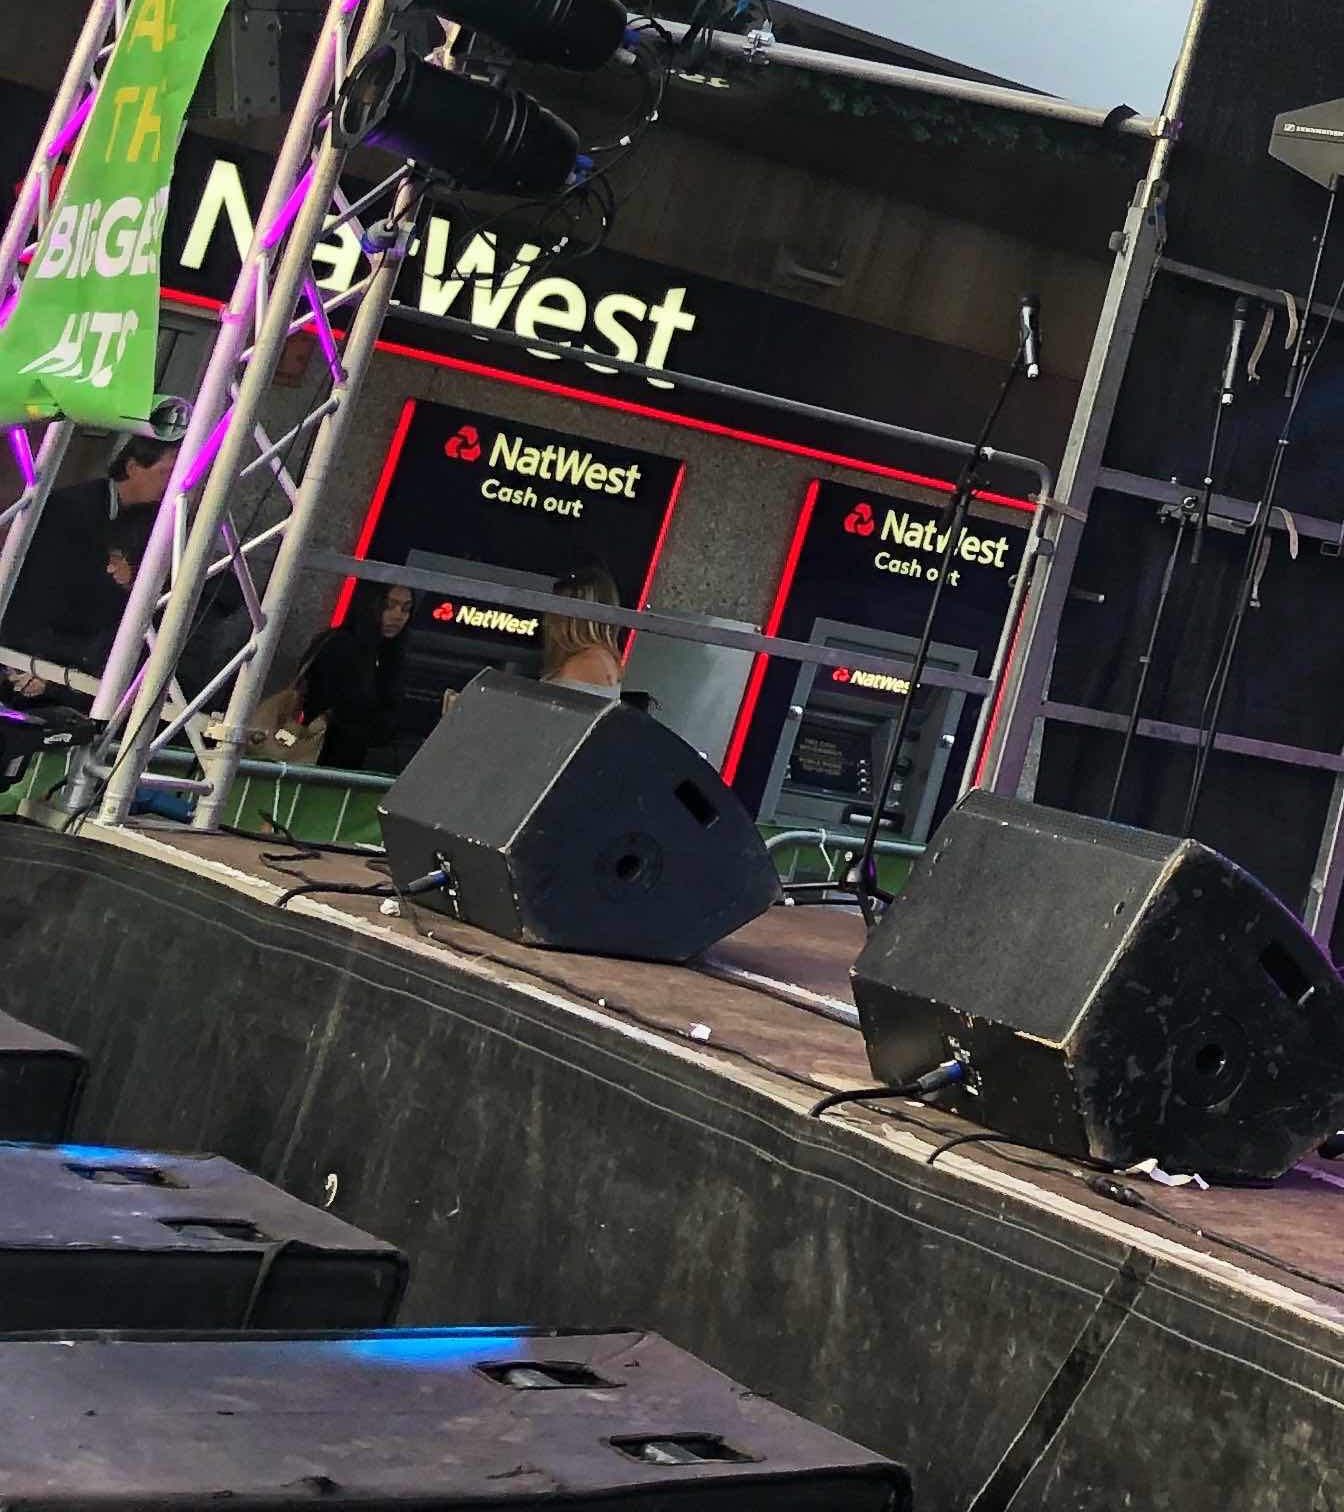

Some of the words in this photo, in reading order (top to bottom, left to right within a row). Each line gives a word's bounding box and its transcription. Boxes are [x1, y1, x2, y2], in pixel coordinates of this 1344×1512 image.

[179, 159, 696, 389] NaWest
[488, 432, 641, 498] NatWest
[481, 478, 538, 508] Cash
[543, 496, 584, 518] out
[874, 551, 922, 578] Cash
[926, 567, 960, 587] ot
[455, 605, 539, 636] NatWest
[850, 669, 921, 695] NatWes
